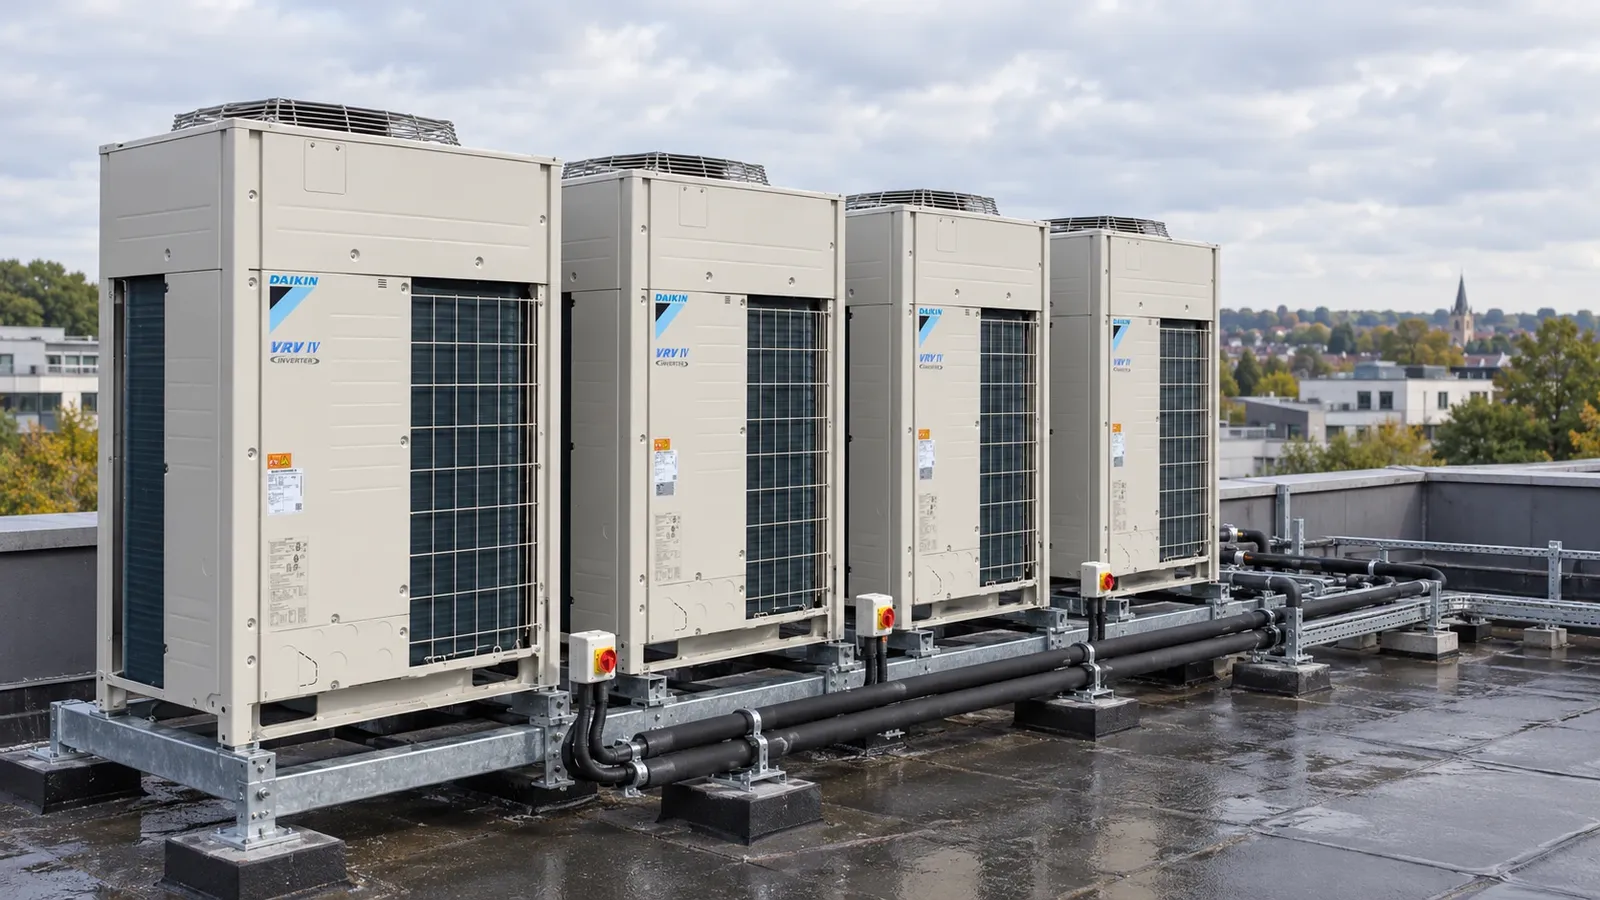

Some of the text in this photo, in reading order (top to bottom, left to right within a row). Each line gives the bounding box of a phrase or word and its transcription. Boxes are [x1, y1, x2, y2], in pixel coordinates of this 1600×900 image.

[269, 274, 319, 286] DAIKIN
[655, 293, 688, 302] DAIKIN
[919, 307, 943, 316] DAIKIN
[270, 341, 321, 354] VRV IV
[656, 347, 690, 358] VRV IV
